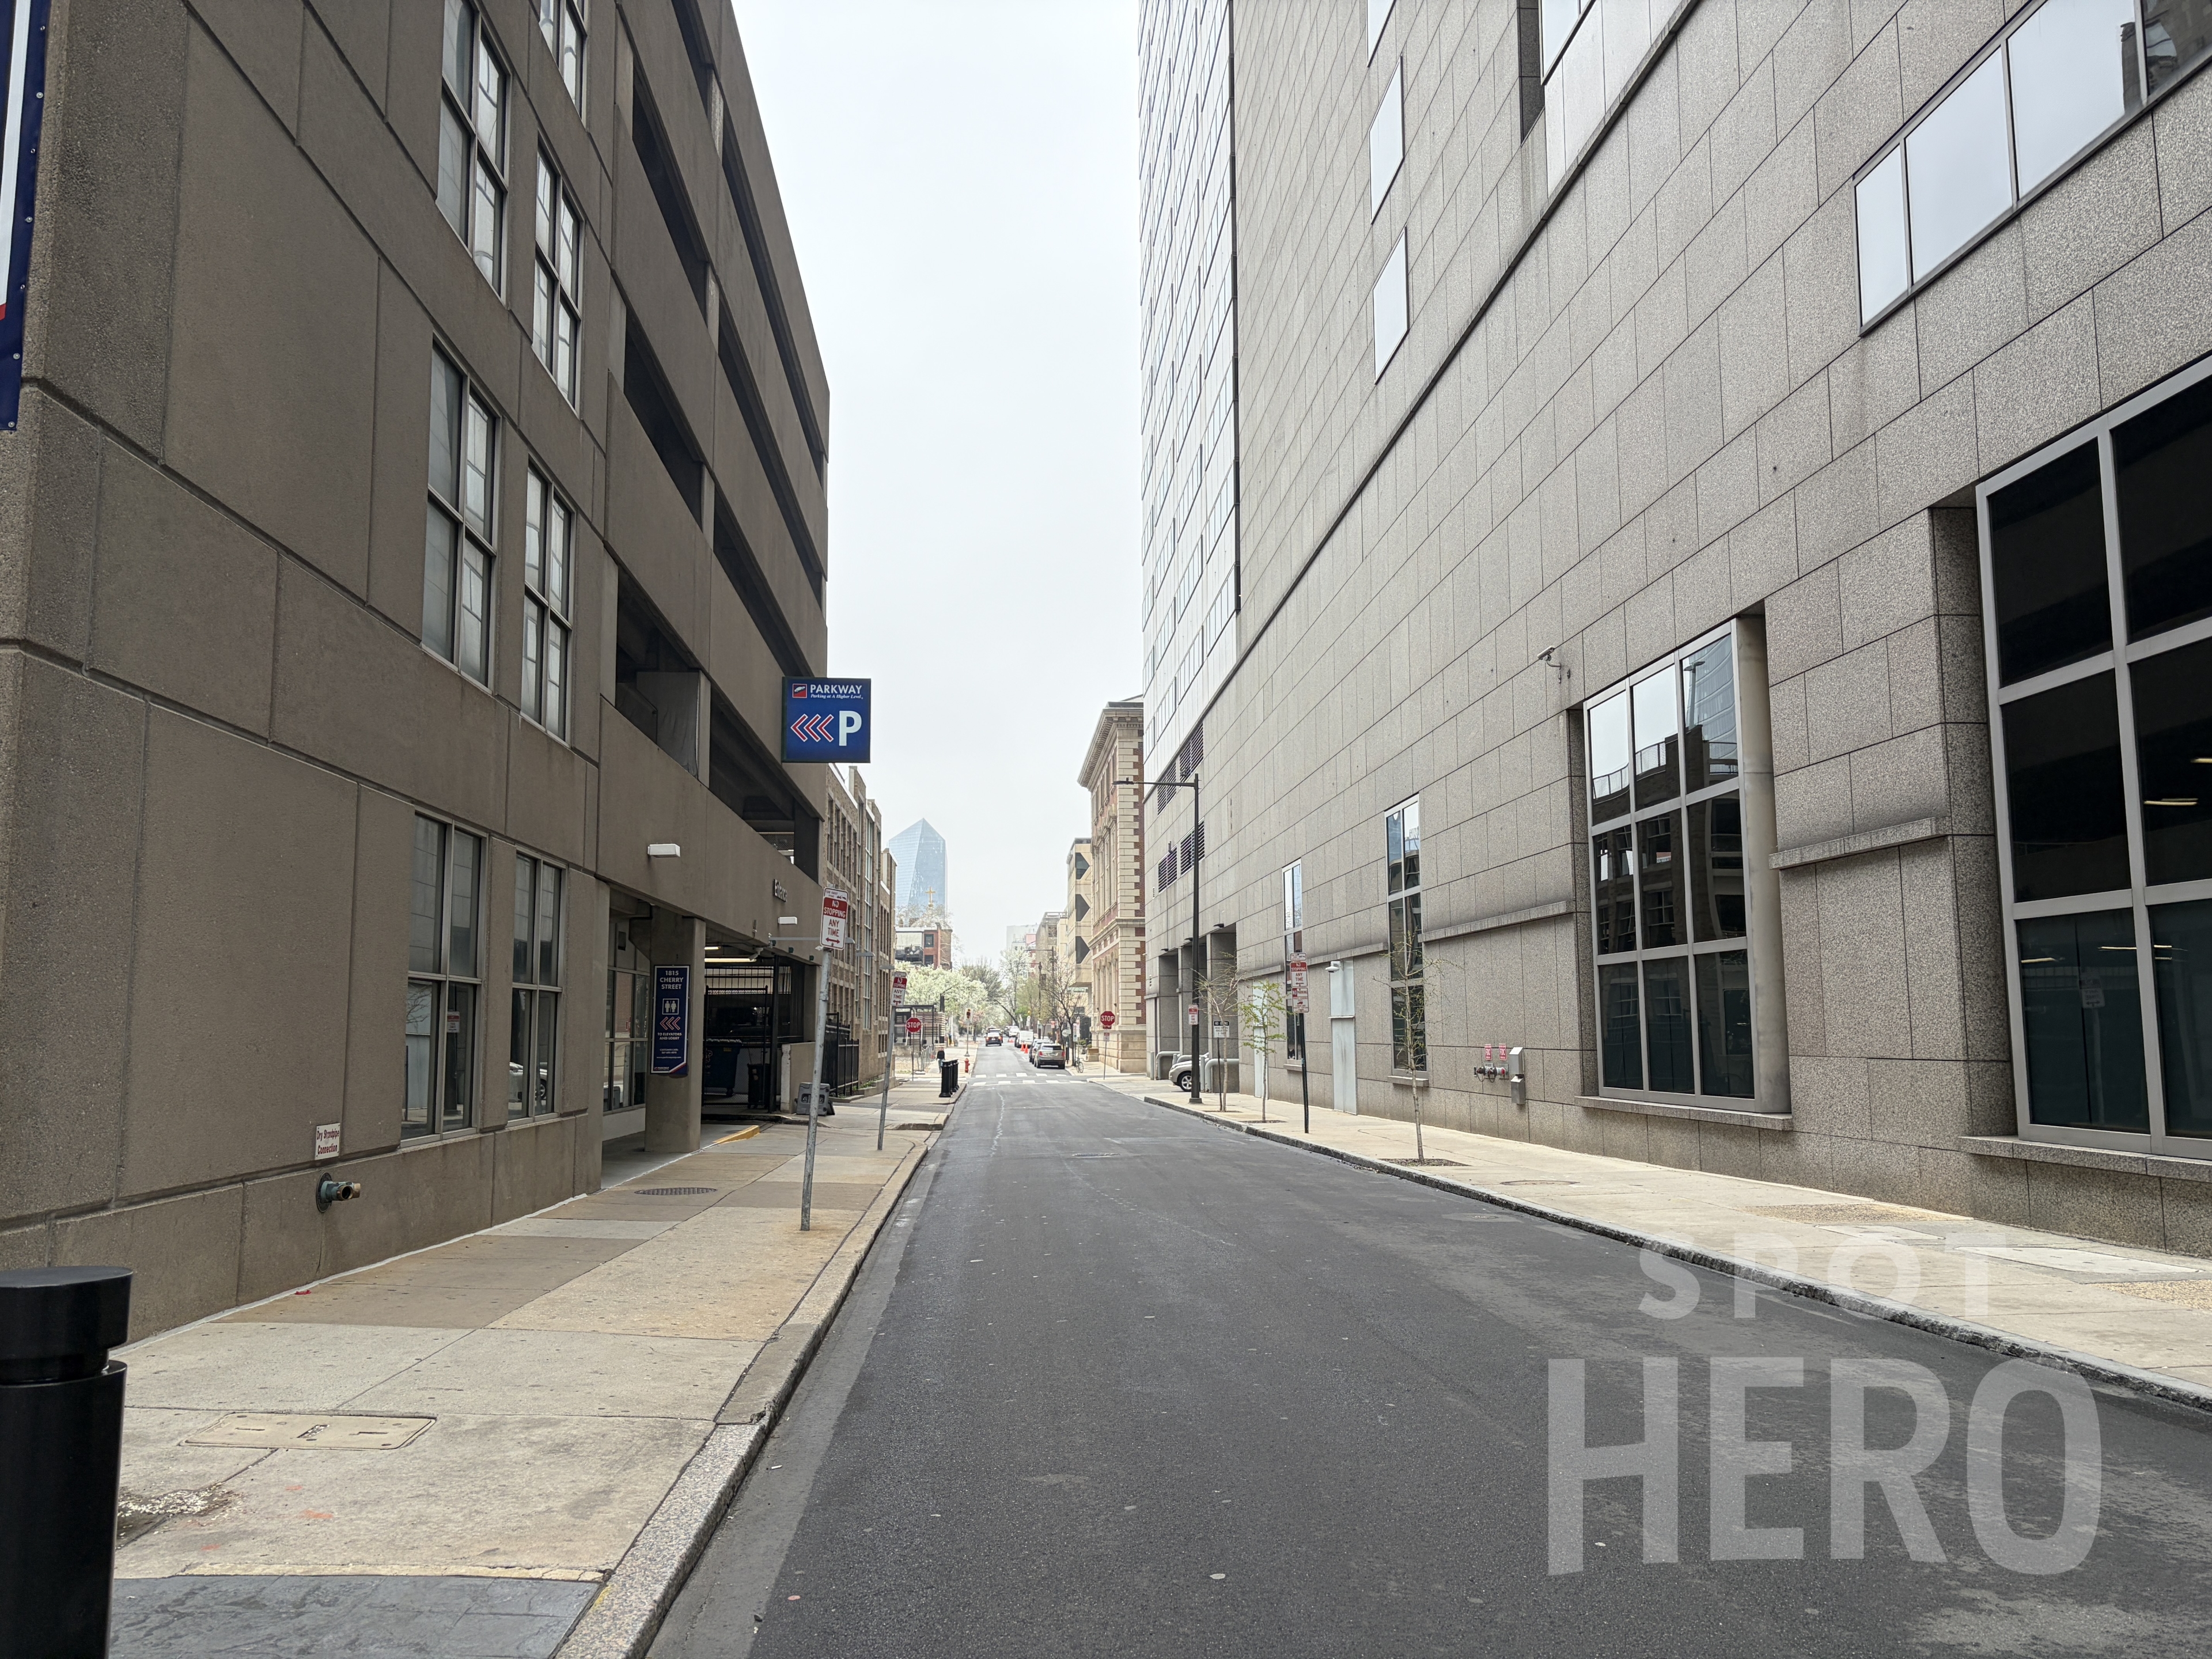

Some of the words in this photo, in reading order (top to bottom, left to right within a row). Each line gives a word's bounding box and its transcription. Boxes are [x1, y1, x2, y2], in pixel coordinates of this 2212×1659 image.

[810, 684, 862, 694] PARKWAY
[839, 710, 862, 746] P
[832, 900, 839, 908] NO
[823, 907, 846, 918] STOPPING
[828, 919, 839, 927] ANY
[828, 927, 839, 937] TIME
[324, 1128, 339, 1139] Standpipe
[318, 1143, 338, 1154] Connection
